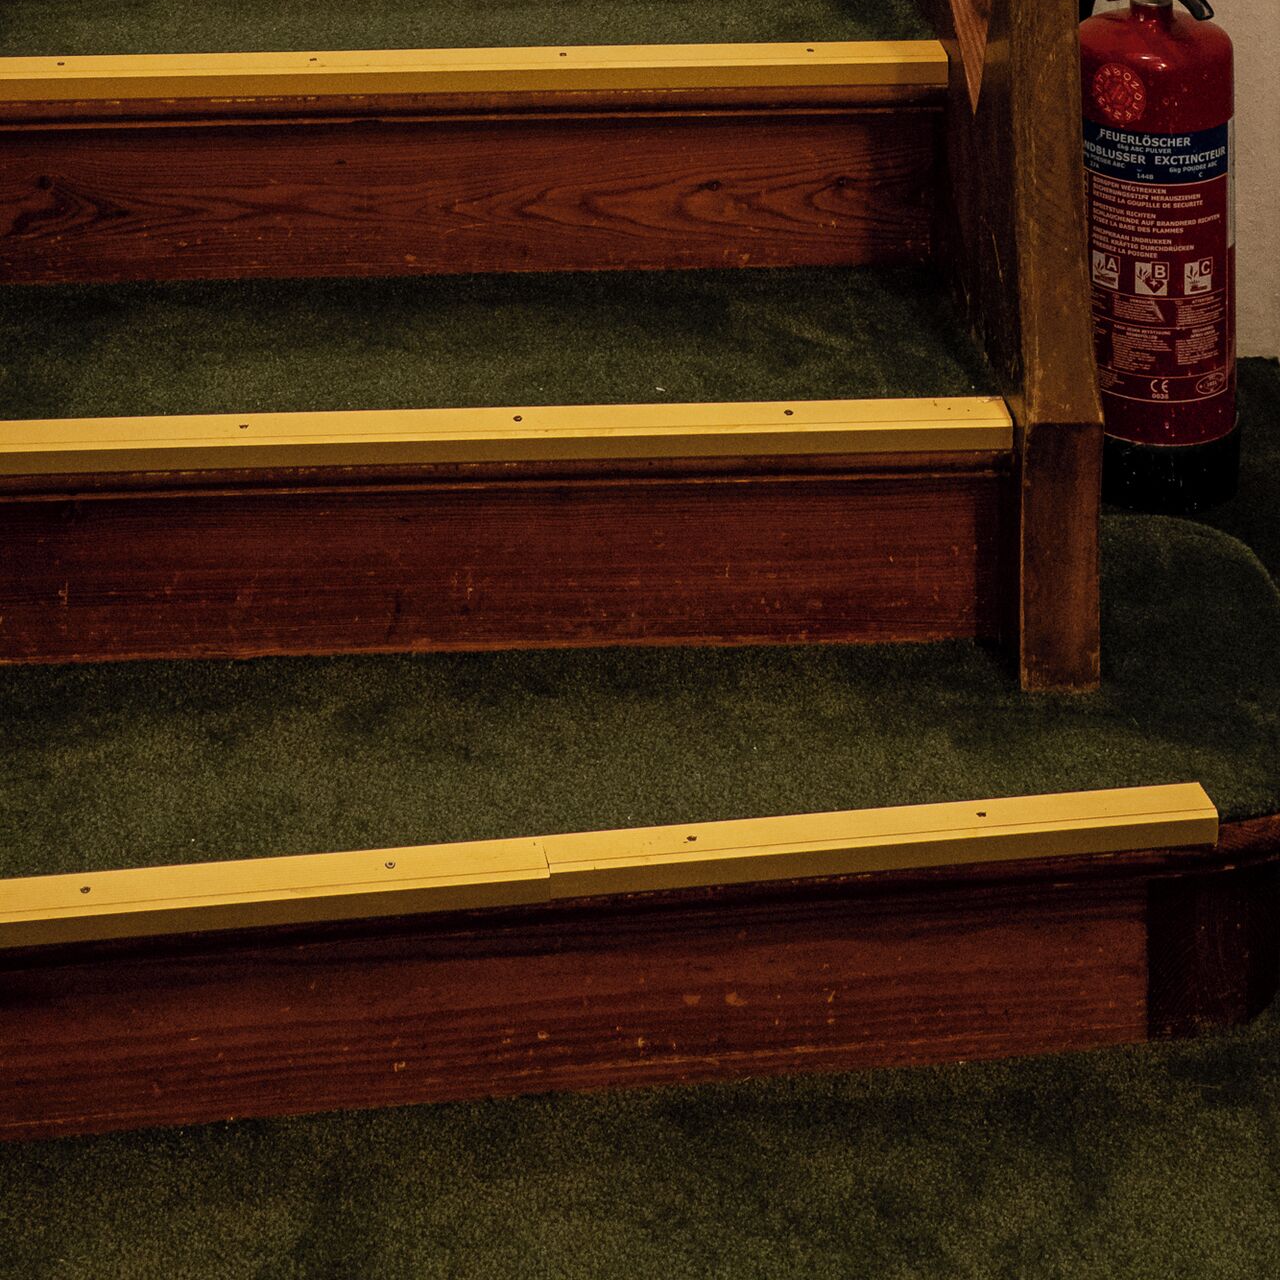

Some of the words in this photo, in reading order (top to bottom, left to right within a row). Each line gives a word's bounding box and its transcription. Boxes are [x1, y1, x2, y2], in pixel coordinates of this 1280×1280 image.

[1100, 128, 1191, 147] FEUERLÖSCHER
[1154, 145, 1226, 165] EXCTINCTEUR
[1117, 197, 1126, 205] LA
[1127, 199, 1161, 208] GOUPILLE
[1126, 210, 1156, 219] RICHTEN
[1119, 223, 1136, 231] BASE
[1152, 226, 1184, 234] FLAMMES
[1141, 219, 1155, 227] AUF
[1156, 219, 1197, 227] BRANDHERD
[1117, 247, 1127, 255] LA
[1107, 257, 1118, 271] A
[1200, 260, 1211, 275] C
[1154, 264, 1166, 278] B
